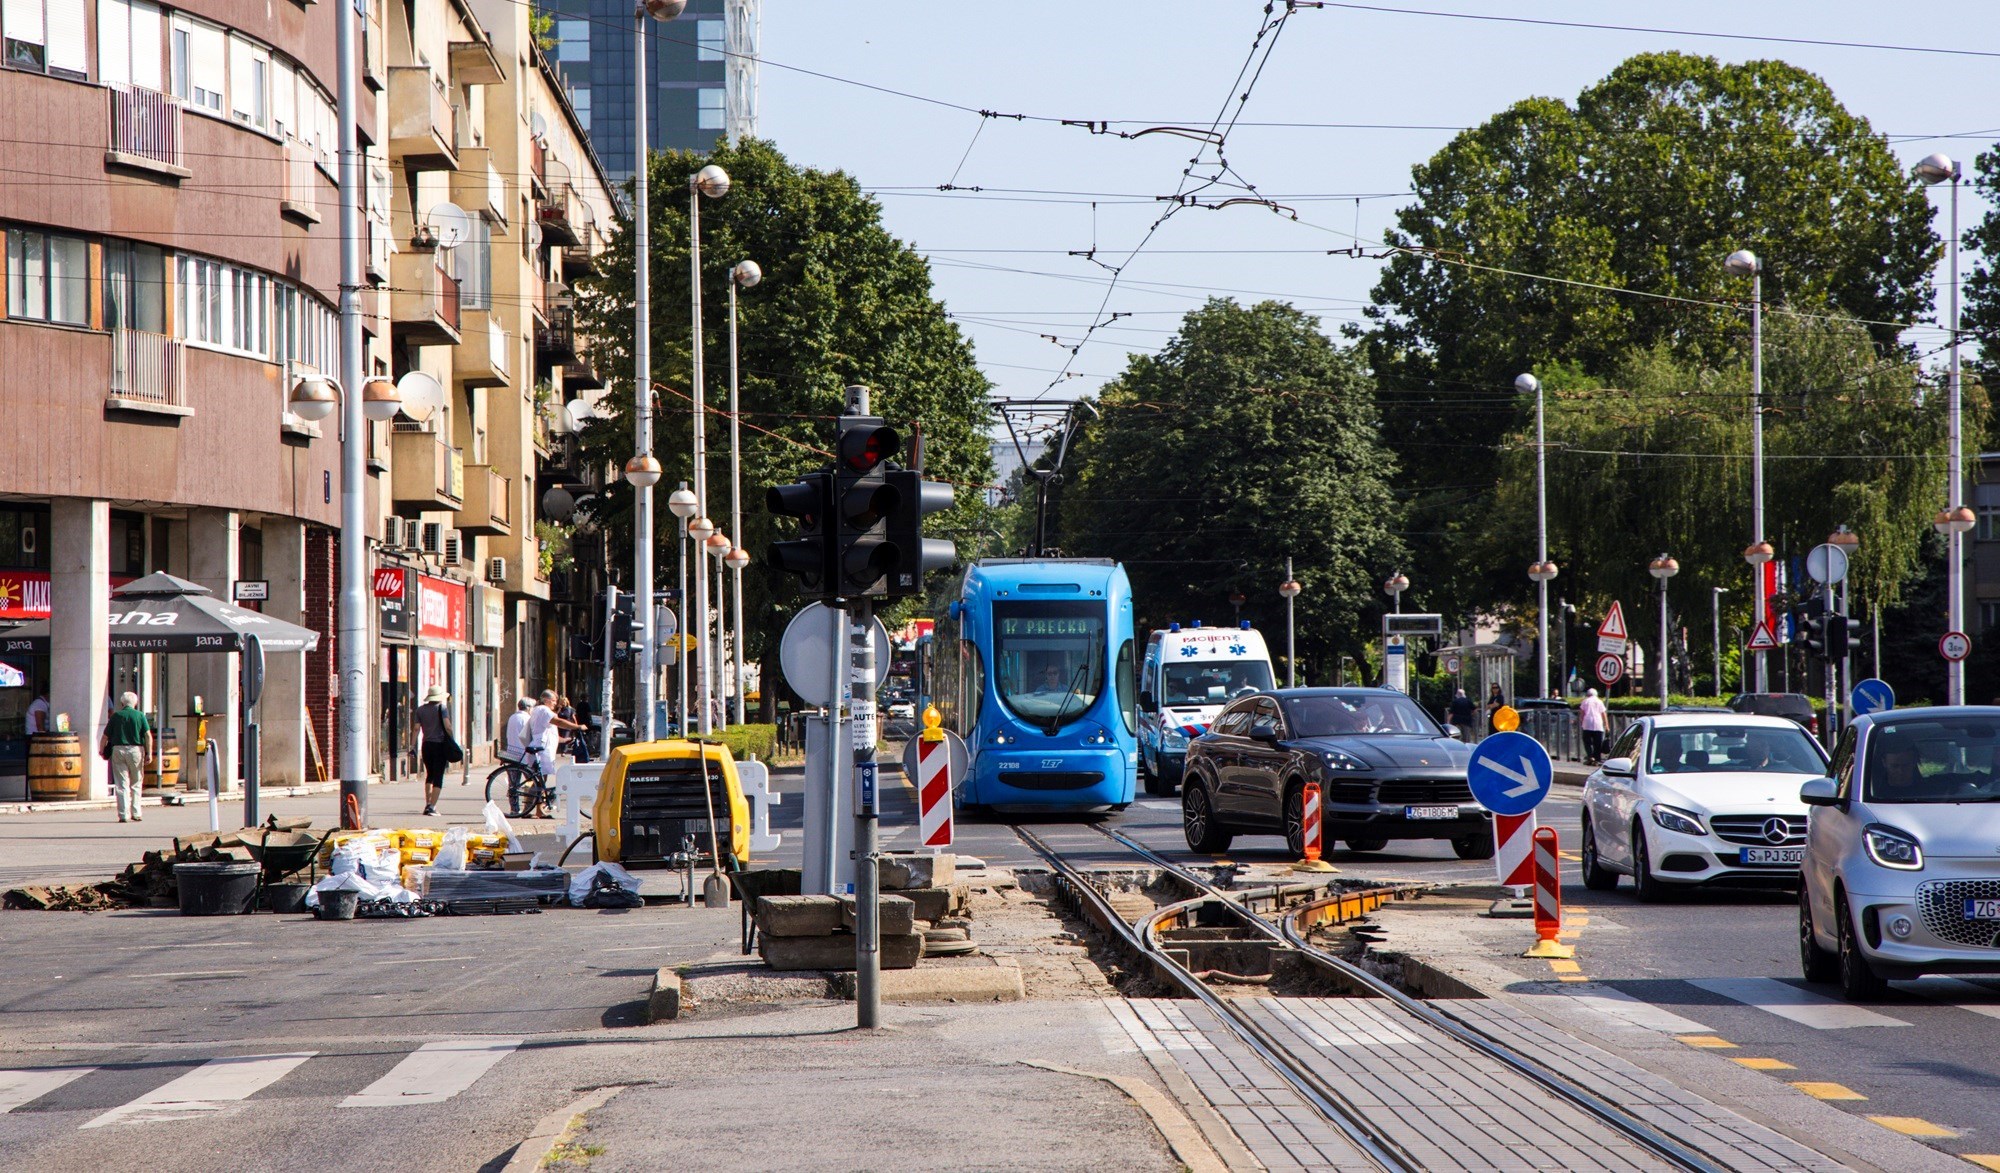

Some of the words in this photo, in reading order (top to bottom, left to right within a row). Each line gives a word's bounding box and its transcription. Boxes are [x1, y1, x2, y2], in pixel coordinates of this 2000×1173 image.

[376, 572, 401, 595] illy
[1004, 618, 1018, 634] 17
[139, 639, 168, 648] WATER
[1601, 660, 1617, 677] 40
[1764, 850, 1779, 861] PJ
[1976, 901, 1996, 917] ZG
